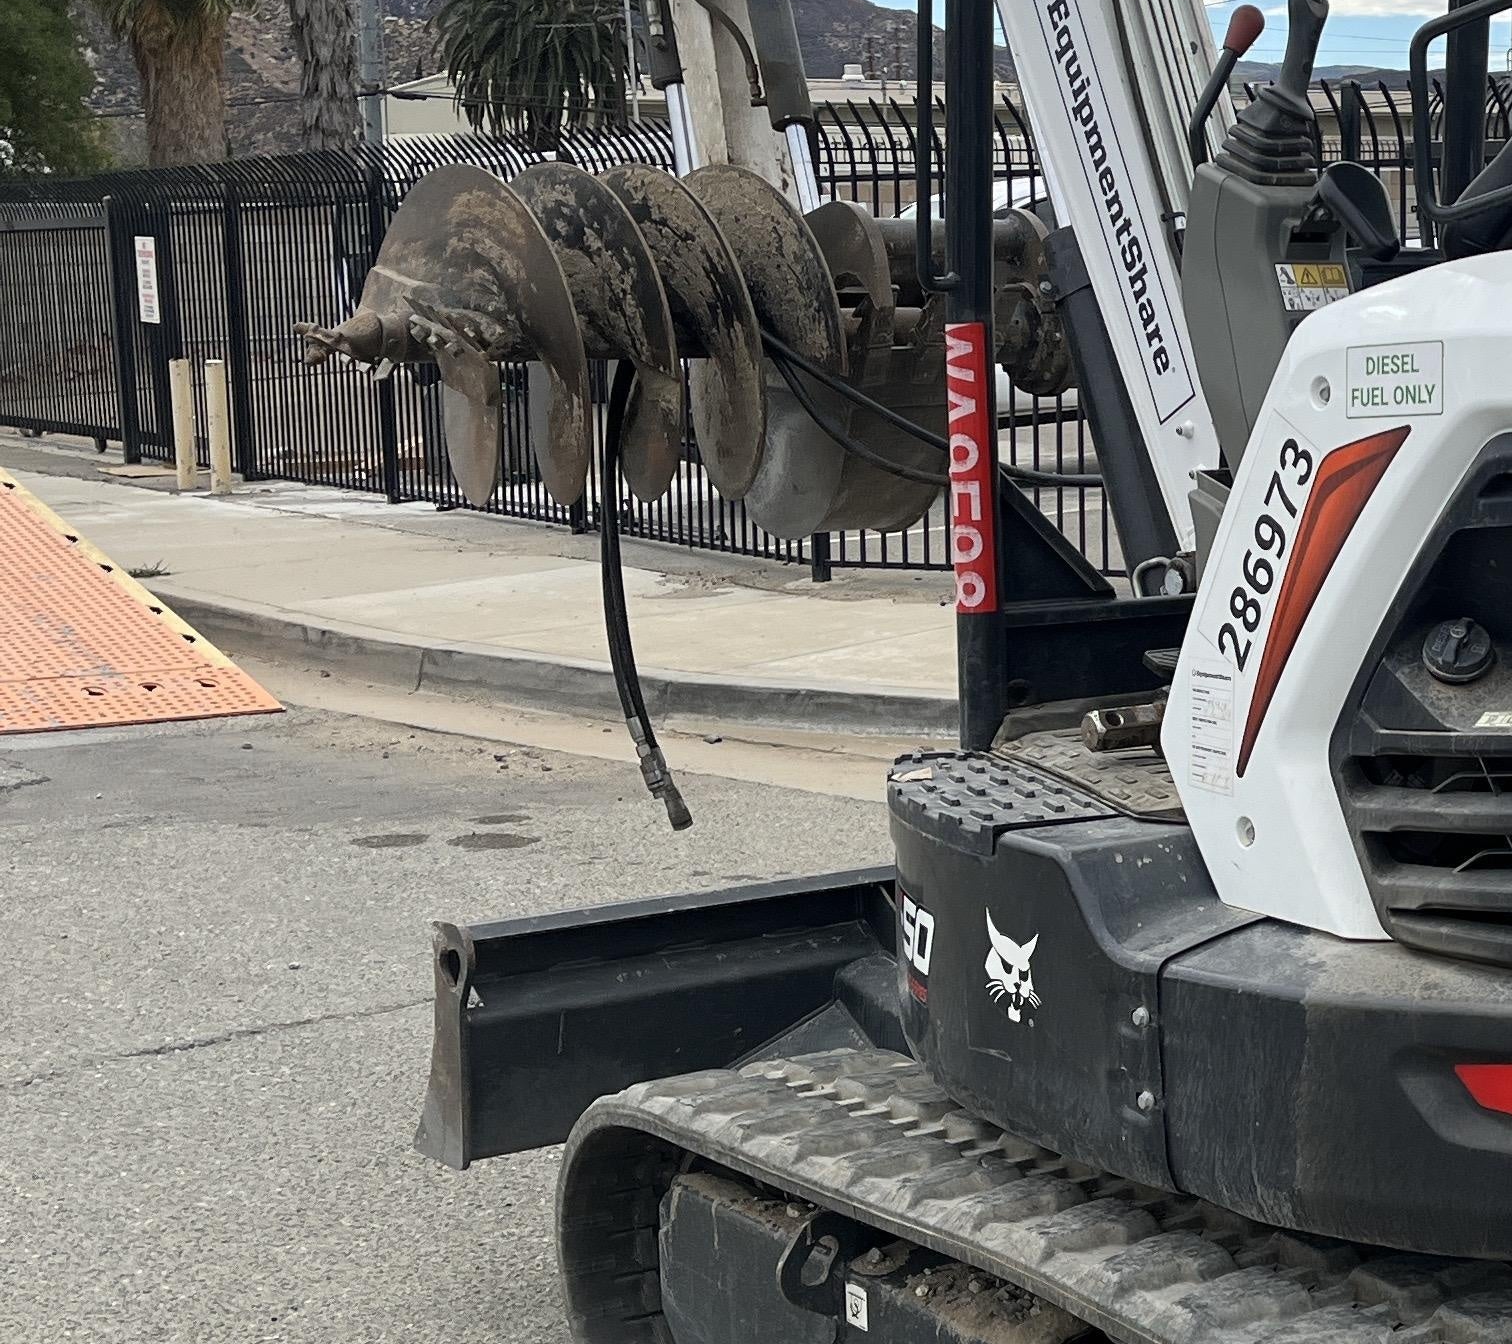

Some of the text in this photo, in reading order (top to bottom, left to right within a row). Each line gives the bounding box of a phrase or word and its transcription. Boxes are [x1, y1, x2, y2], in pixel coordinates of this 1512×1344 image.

[1365, 353, 1420, 377] DIESEL
[1351, 383, 1436, 408] FUEL ONLY
[1217, 437, 1314, 673] 286973
[901, 894, 935, 976] 50
